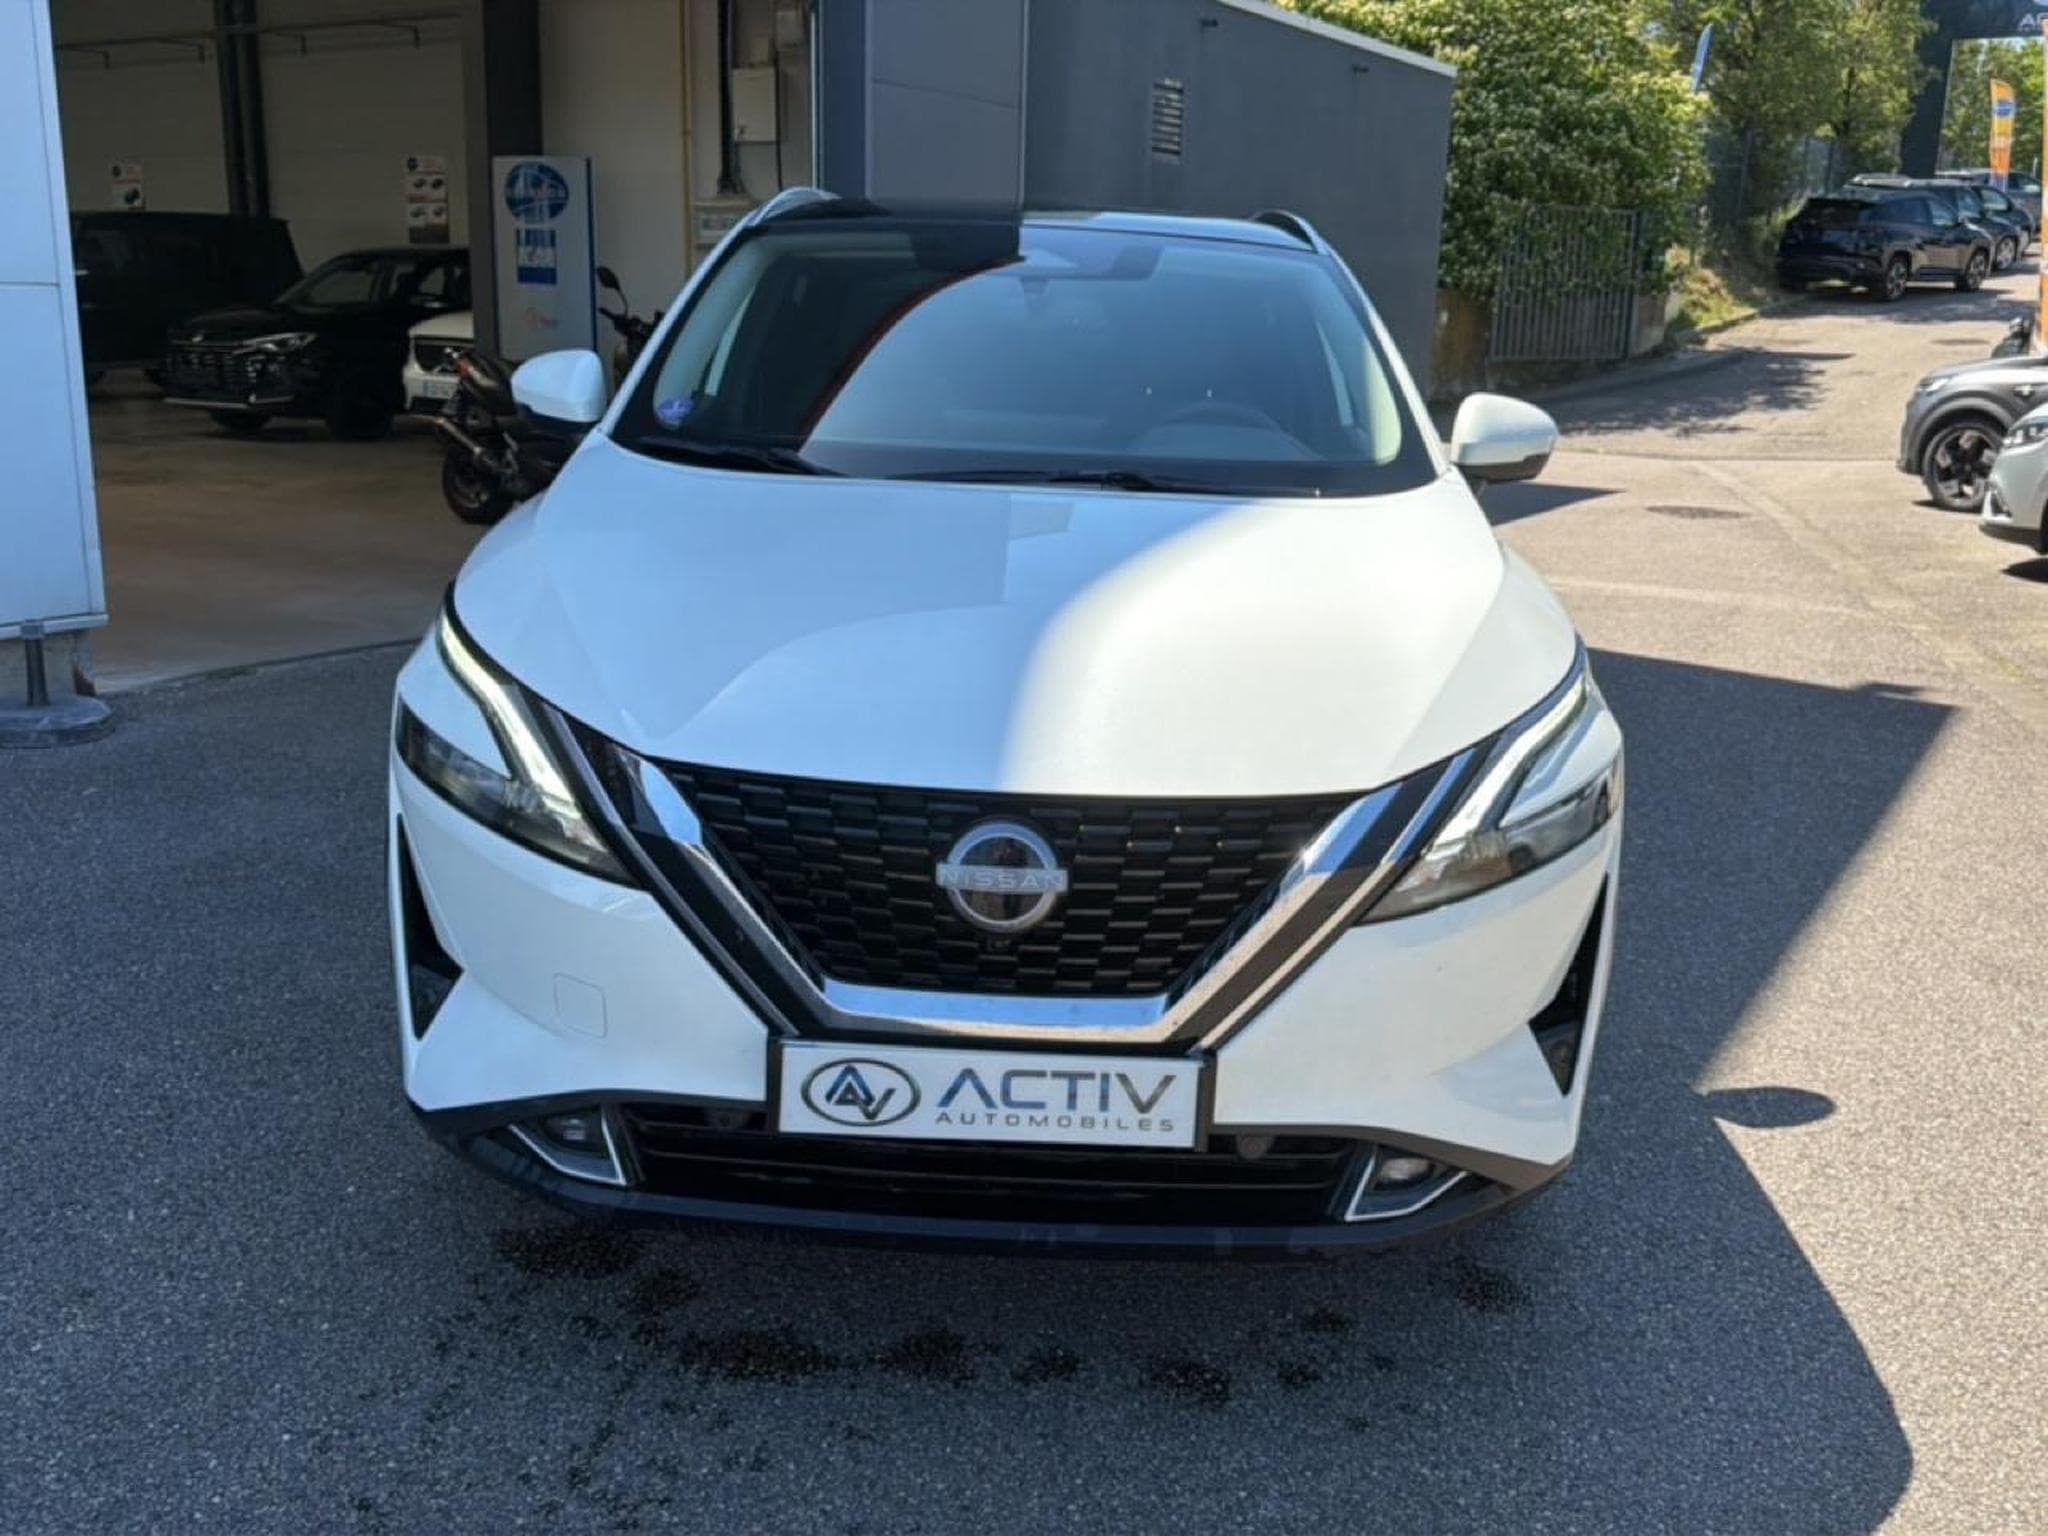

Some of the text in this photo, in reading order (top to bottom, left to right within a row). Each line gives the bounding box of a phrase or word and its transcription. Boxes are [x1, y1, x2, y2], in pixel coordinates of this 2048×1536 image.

[940, 870, 1064, 891] NISSAN
[937, 1067, 1177, 1114] ACTIV
[935, 1111, 1174, 1132] AUTOMOBILES
